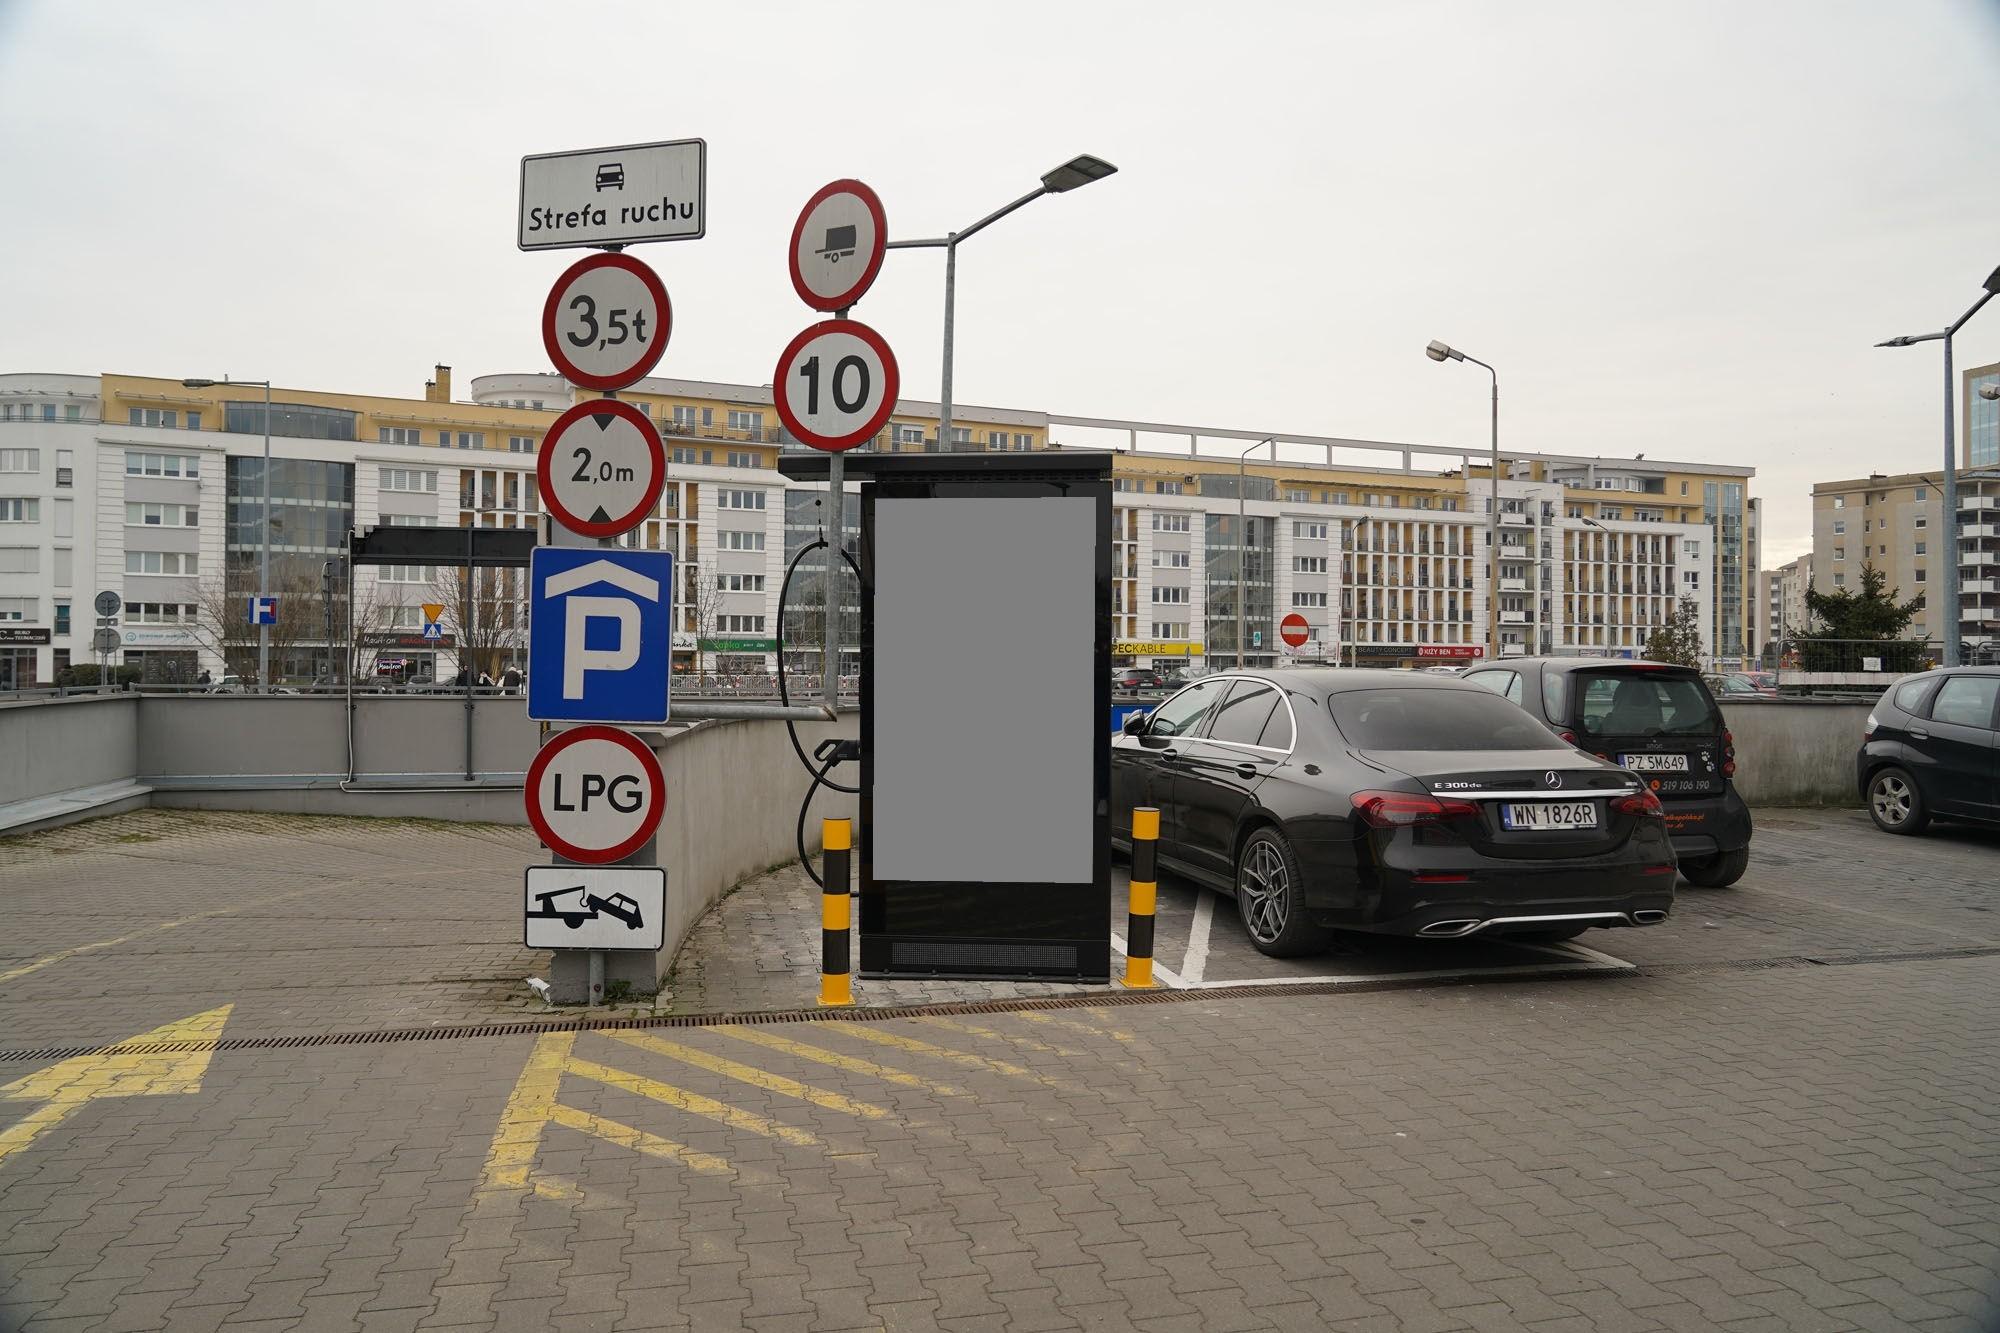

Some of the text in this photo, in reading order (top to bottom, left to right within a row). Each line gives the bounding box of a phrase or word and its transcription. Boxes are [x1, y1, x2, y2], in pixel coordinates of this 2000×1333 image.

[528, 197, 694, 231] Strefa ruchu
[800, 355, 870, 414] 10
[562, 595, 642, 700] P
[1627, 756, 1684, 770] PZ 5M649
[554, 773, 642, 813] LPG
[1662, 781, 1710, 791] 519 106 190
[1514, 804, 1594, 825] WN 1826R
